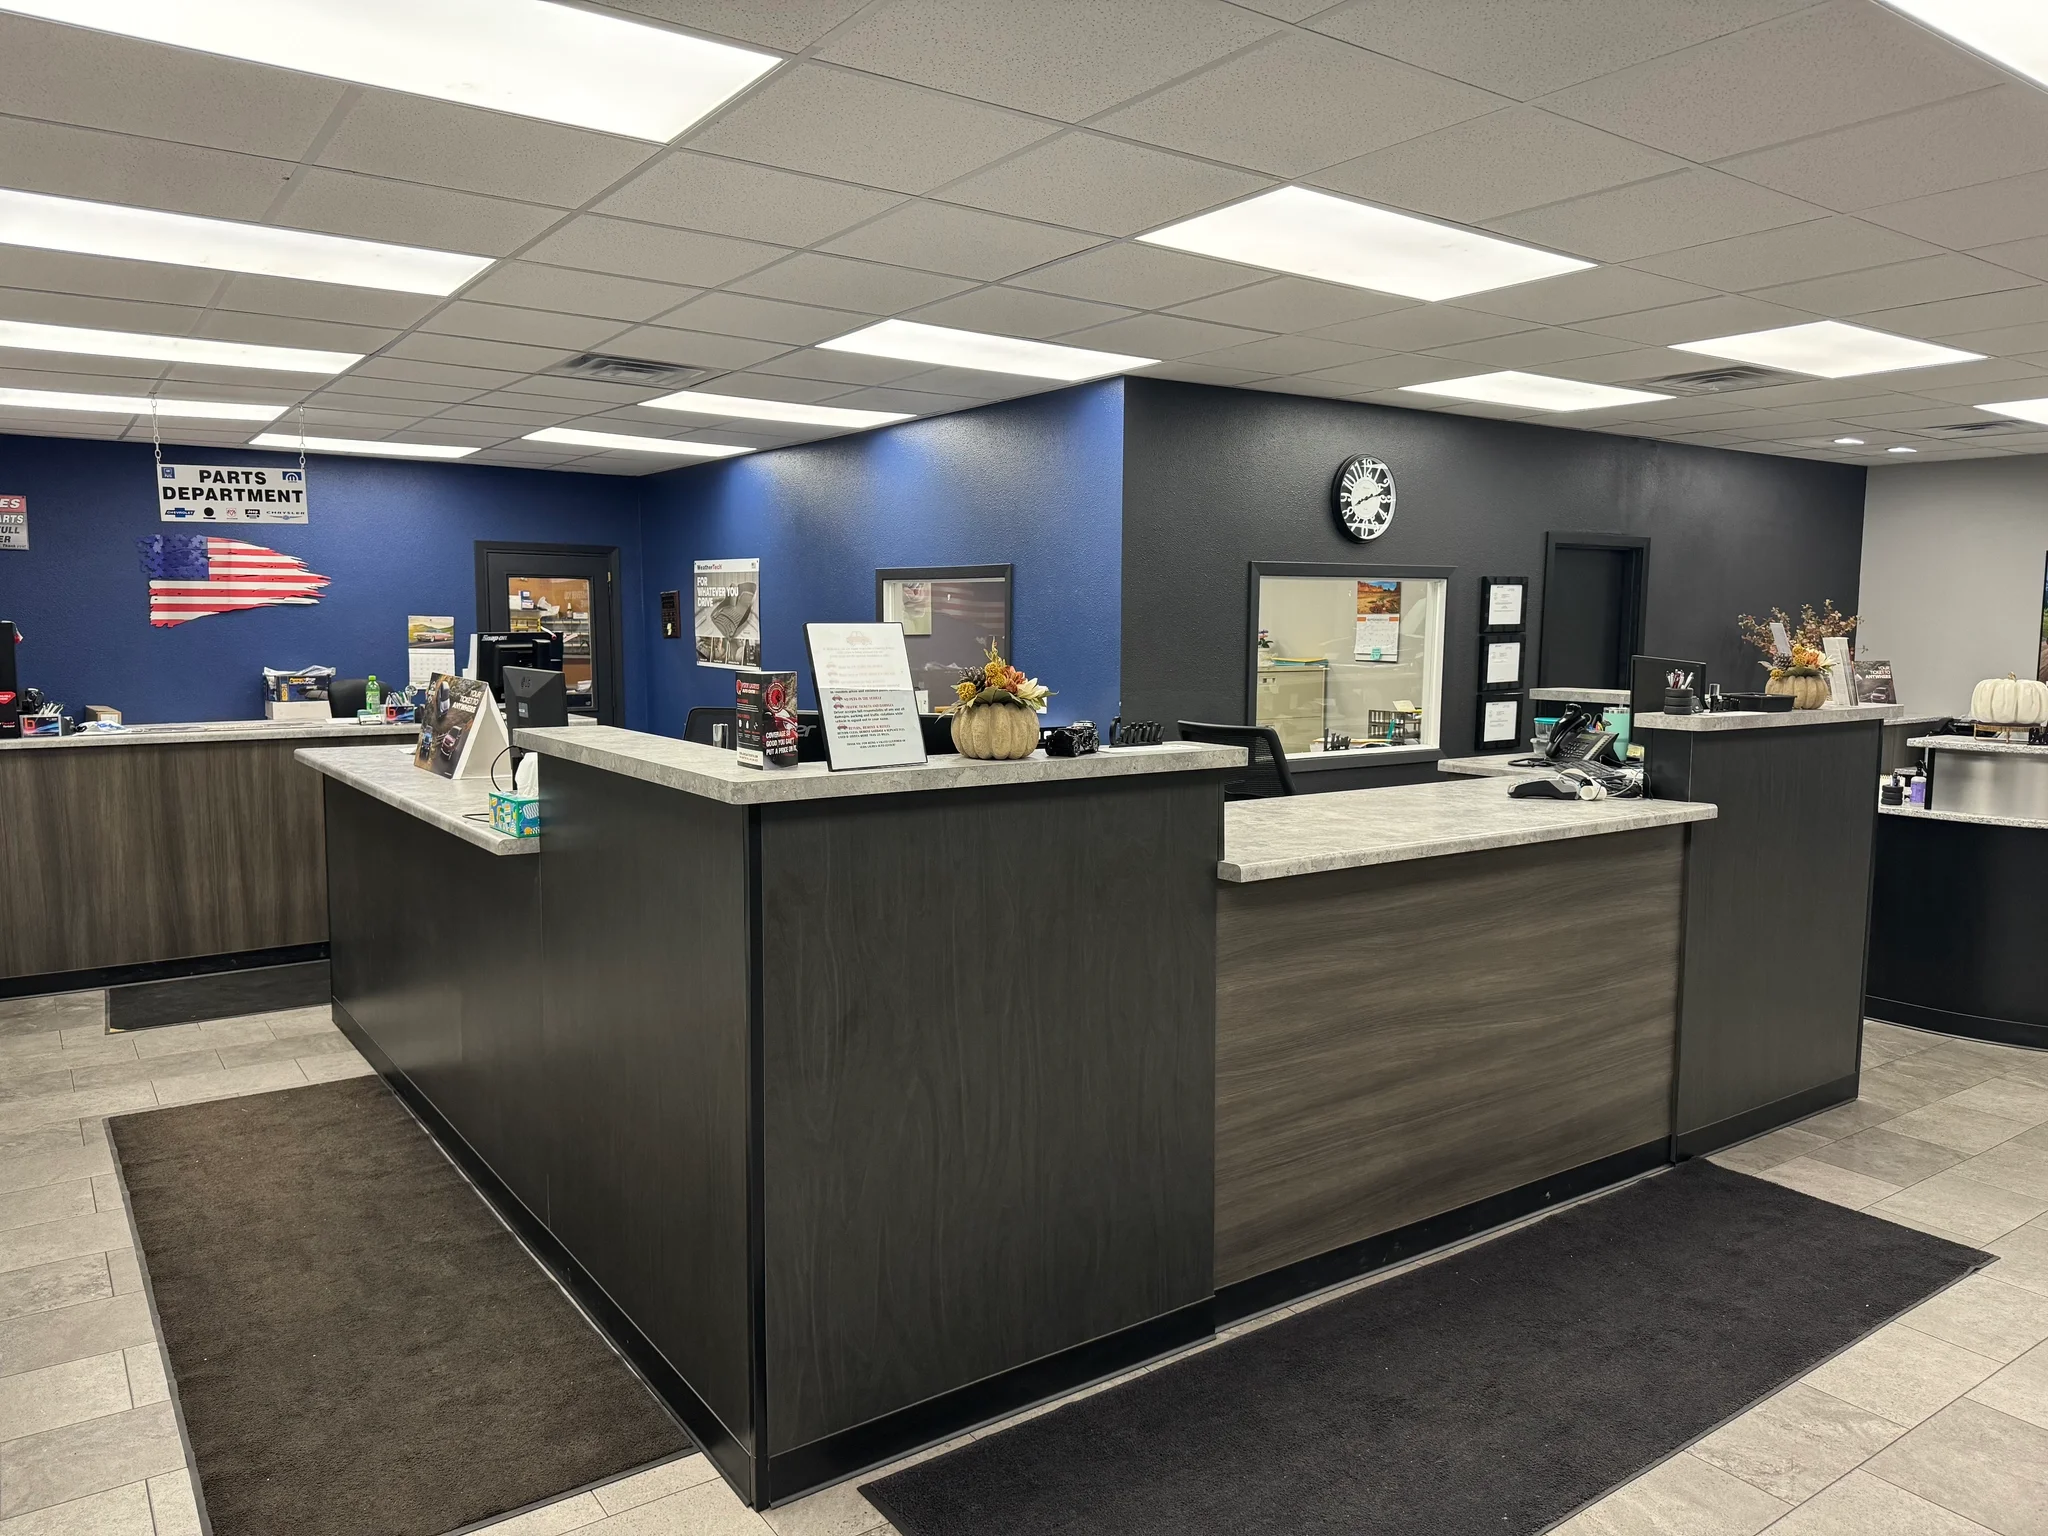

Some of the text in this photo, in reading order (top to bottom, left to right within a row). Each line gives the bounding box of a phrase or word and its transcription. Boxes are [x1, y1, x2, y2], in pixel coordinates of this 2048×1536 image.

[199, 470, 267, 485] PARTS
[162, 486, 303, 503] DEPARTMENT
[0, 514, 24, 524] RTS
[696, 576, 708, 586] FOR
[696, 586, 739, 597] WHATEVER YOU
[697, 597, 714, 607] DRIVE
[481, 634, 508, 642] Snap-on
[470, 690, 482, 699] YOUR
[452, 702, 476, 714] ANYWHERE
[766, 731, 786, 739] COVERAGE
